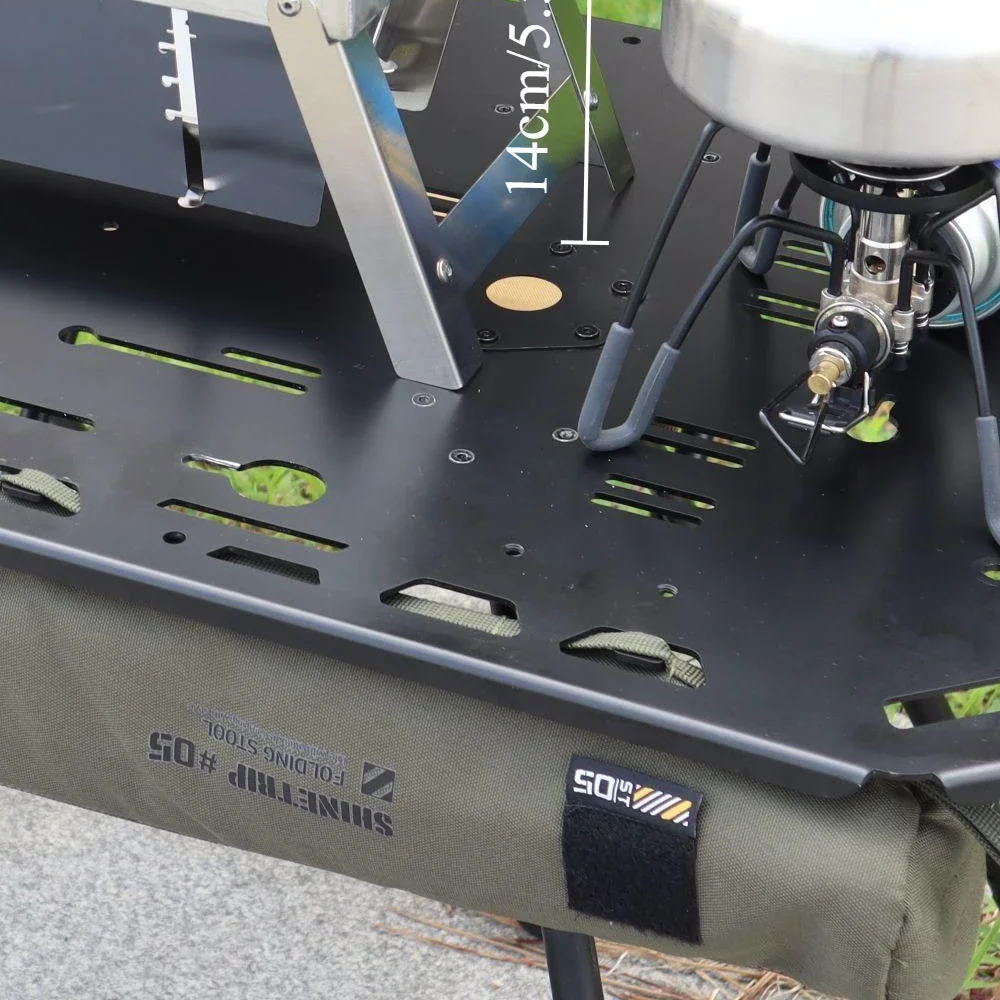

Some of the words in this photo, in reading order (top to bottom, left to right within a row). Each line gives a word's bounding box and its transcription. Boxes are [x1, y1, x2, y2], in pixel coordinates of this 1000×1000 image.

[204, 719, 259, 755] STOOL
[263, 746, 345, 786] FOLDING
[228, 763, 394, 837] SHINETRIP
